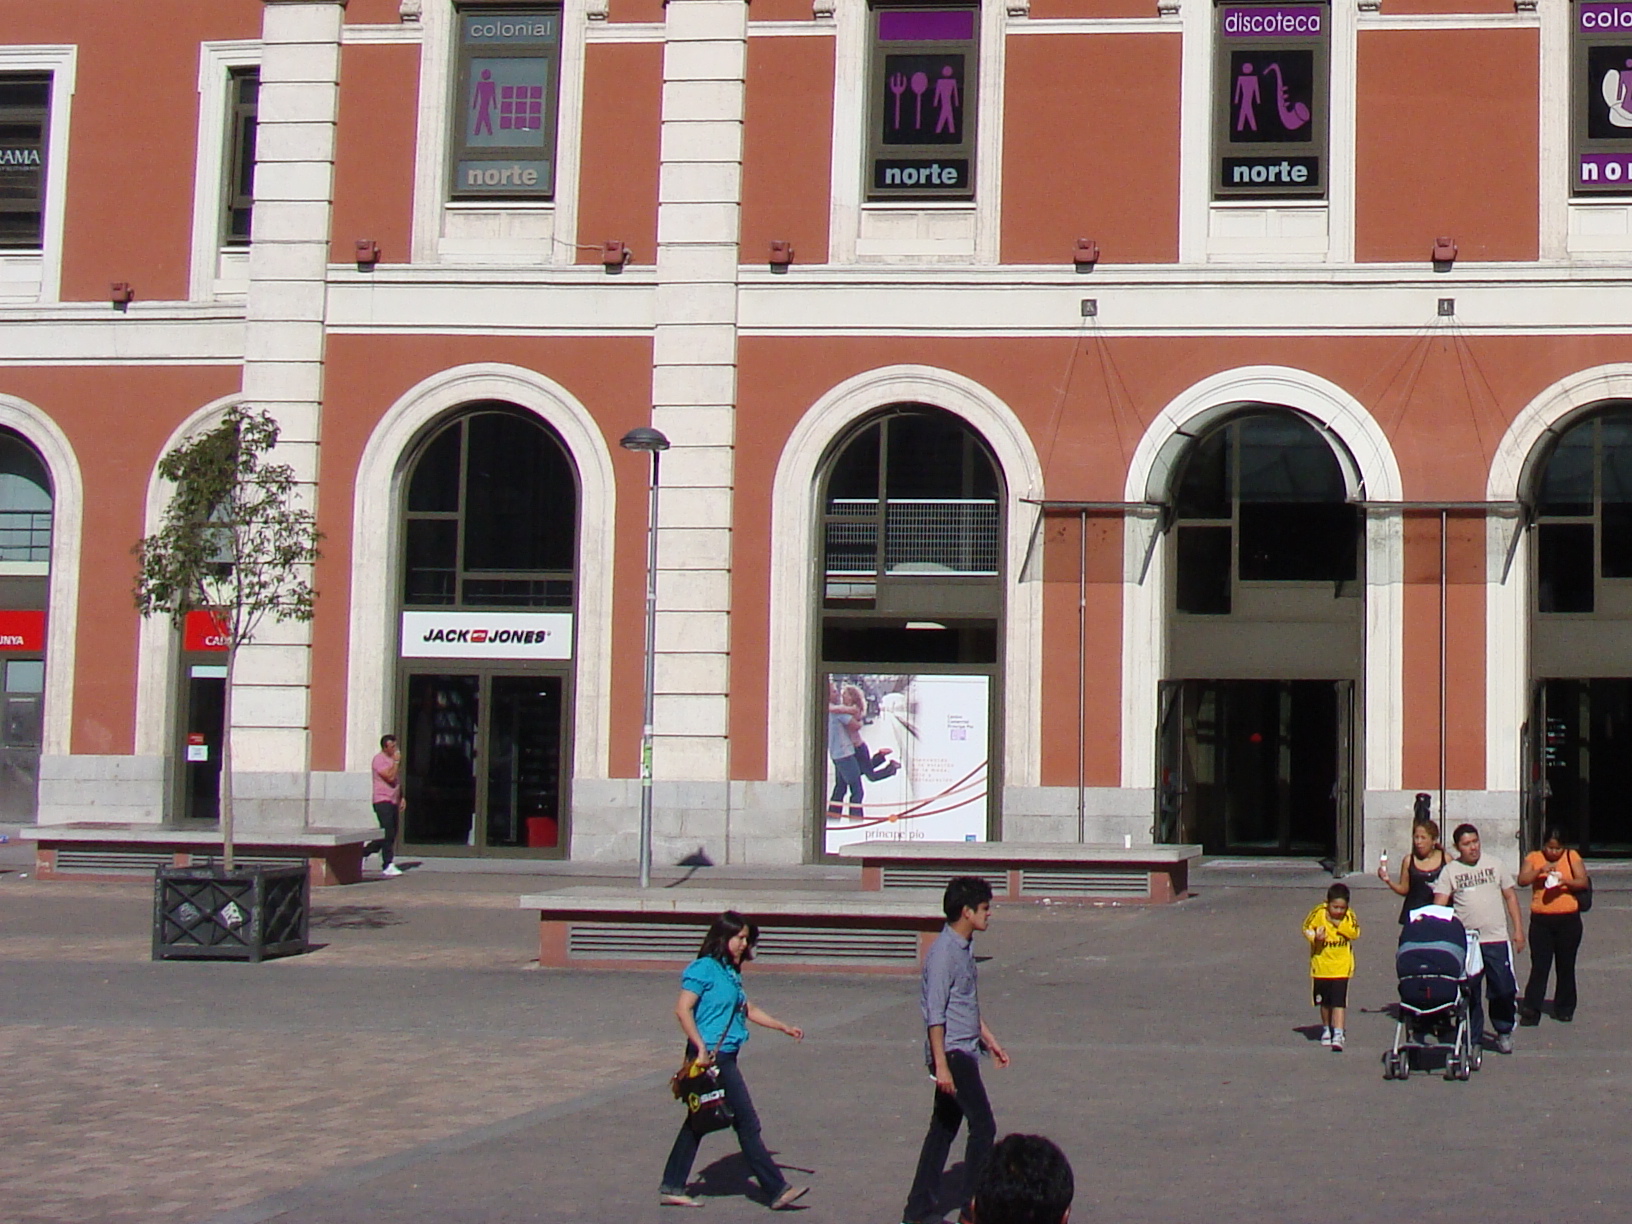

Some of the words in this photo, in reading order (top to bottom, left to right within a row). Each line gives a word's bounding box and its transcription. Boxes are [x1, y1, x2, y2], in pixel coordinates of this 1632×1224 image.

[471, 21, 550, 37] colonial
[1225, 12, 1320, 32] discoteca
[467, 165, 538, 185] norte
[885, 164, 958, 184] norte
[1233, 161, 1308, 182] norte
[423, 628, 471, 643] JACK
[488, 630, 546, 644] JONES
